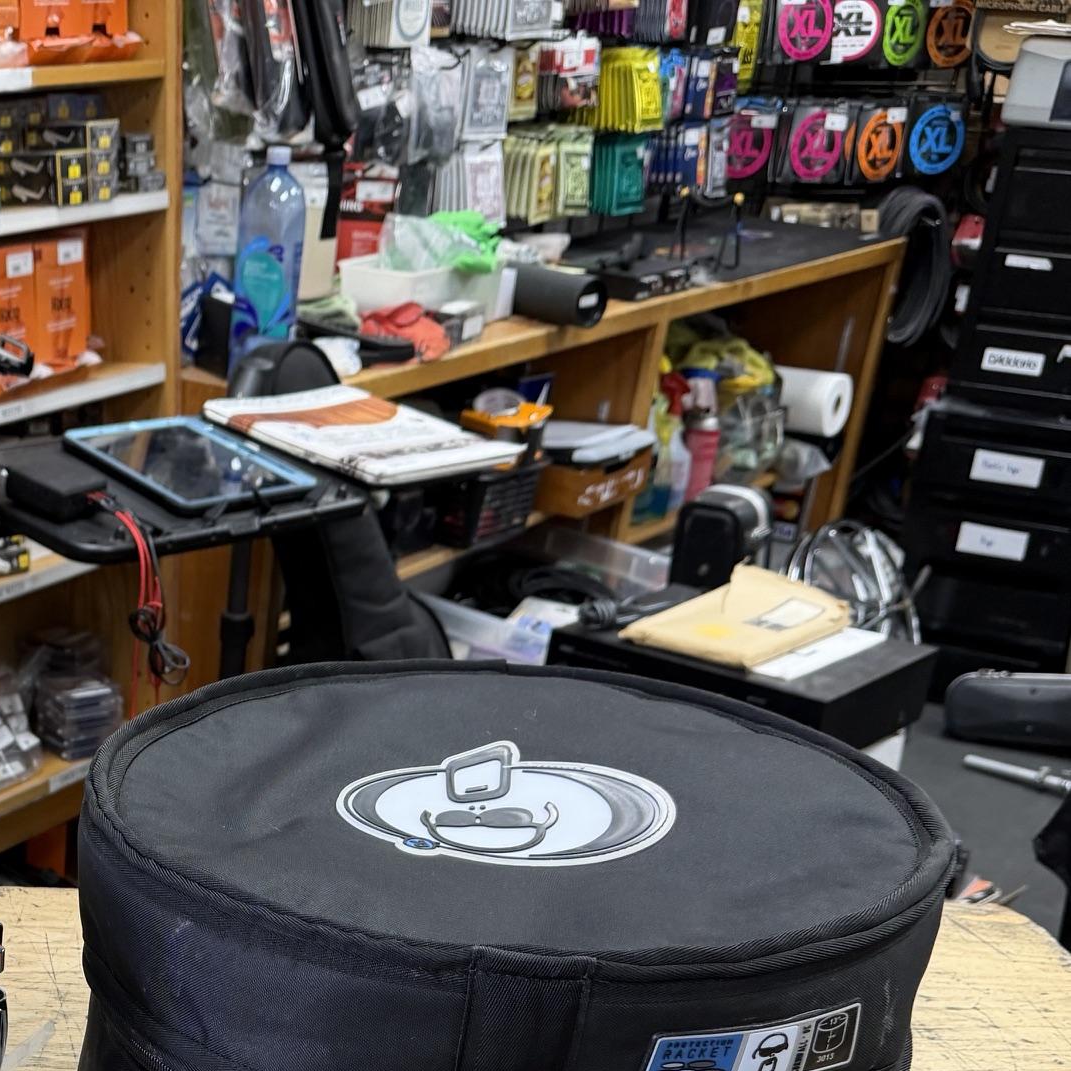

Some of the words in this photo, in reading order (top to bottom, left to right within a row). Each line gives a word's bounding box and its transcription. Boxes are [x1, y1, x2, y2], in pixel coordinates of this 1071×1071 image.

[790, 9, 823, 38] XL
[892, 14, 916, 44] XL
[919, 126, 953, 153] XL
[662, 1045, 731, 1060] RACKET
[666, 1038, 734, 1049] PROTECTION
